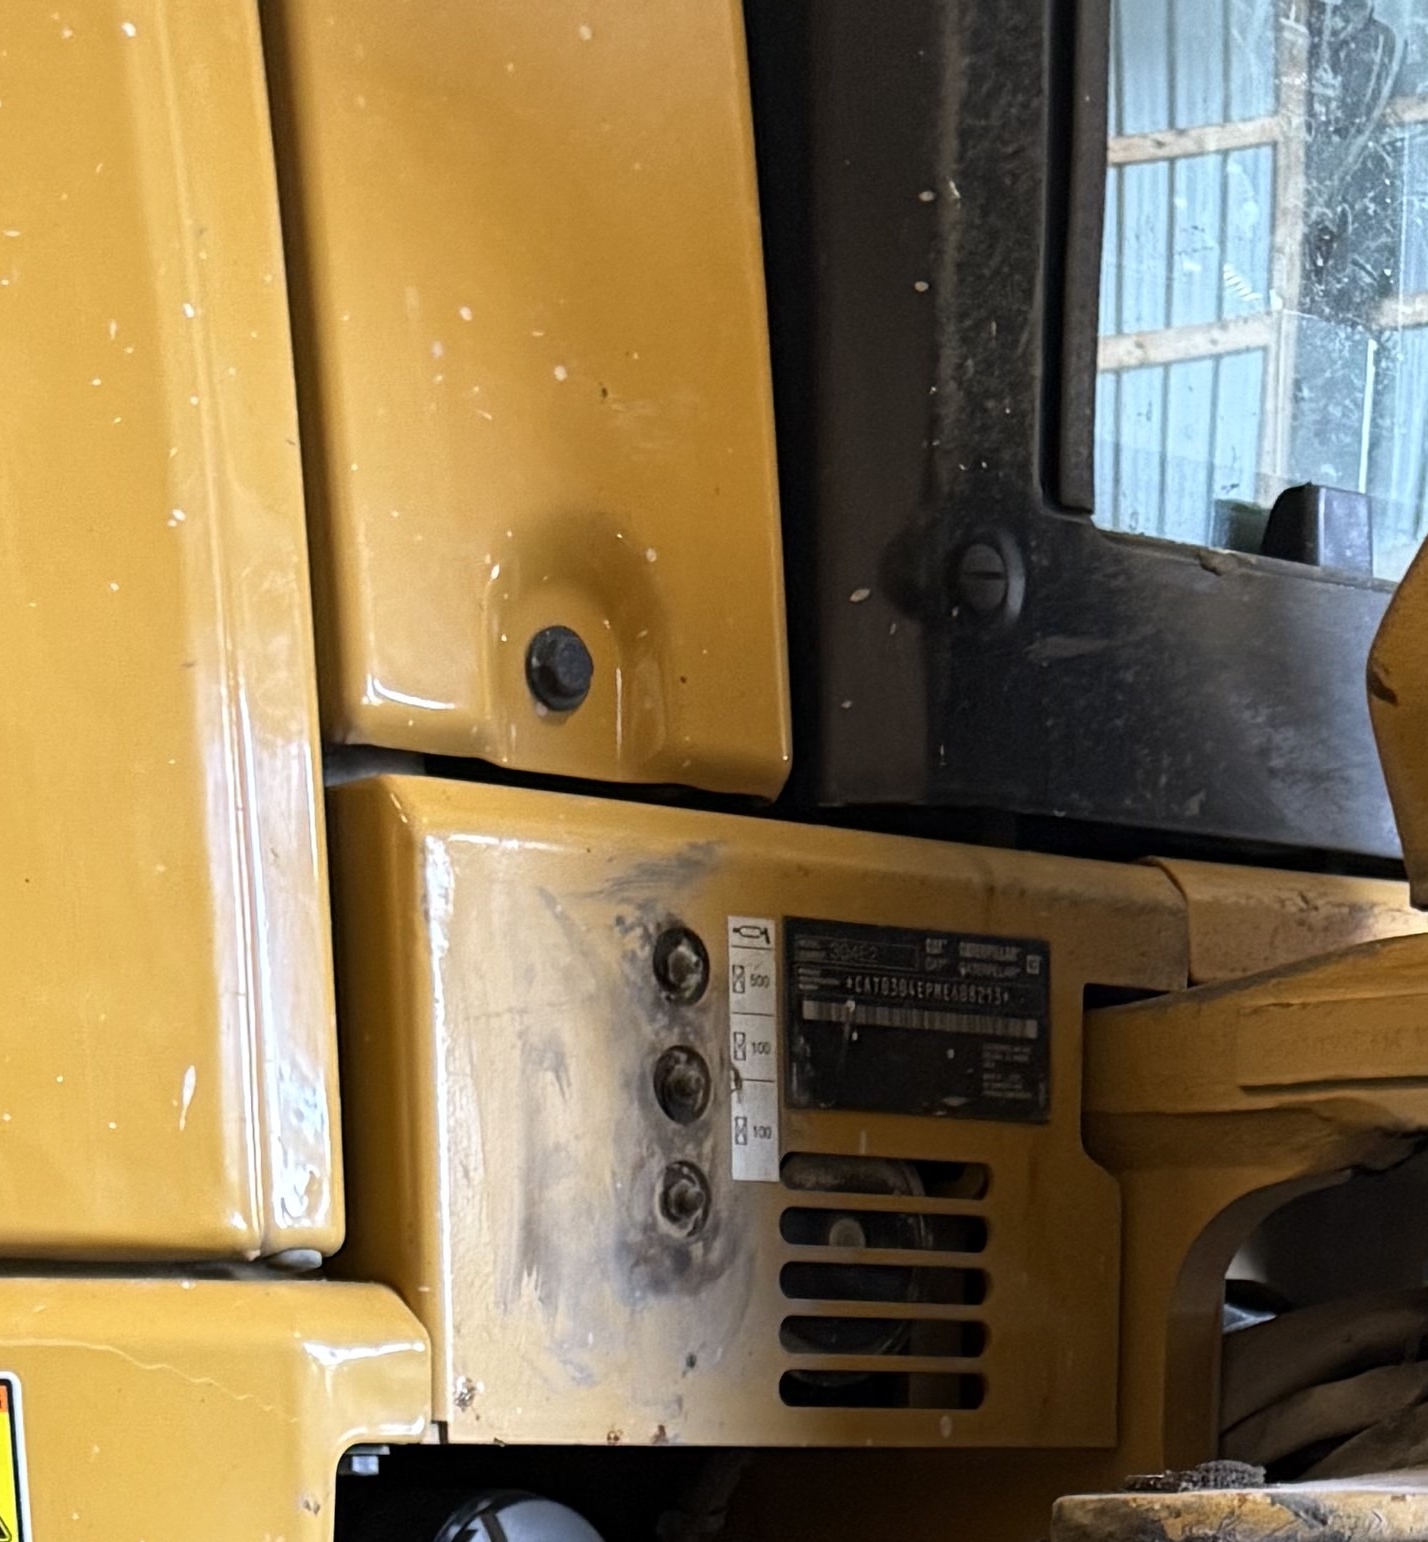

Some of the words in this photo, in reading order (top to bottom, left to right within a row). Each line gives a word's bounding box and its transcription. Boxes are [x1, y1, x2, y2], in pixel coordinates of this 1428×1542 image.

[750, 974, 770, 988] 500
[751, 1041, 771, 1056] 100
[752, 1125, 772, 1140] 100
